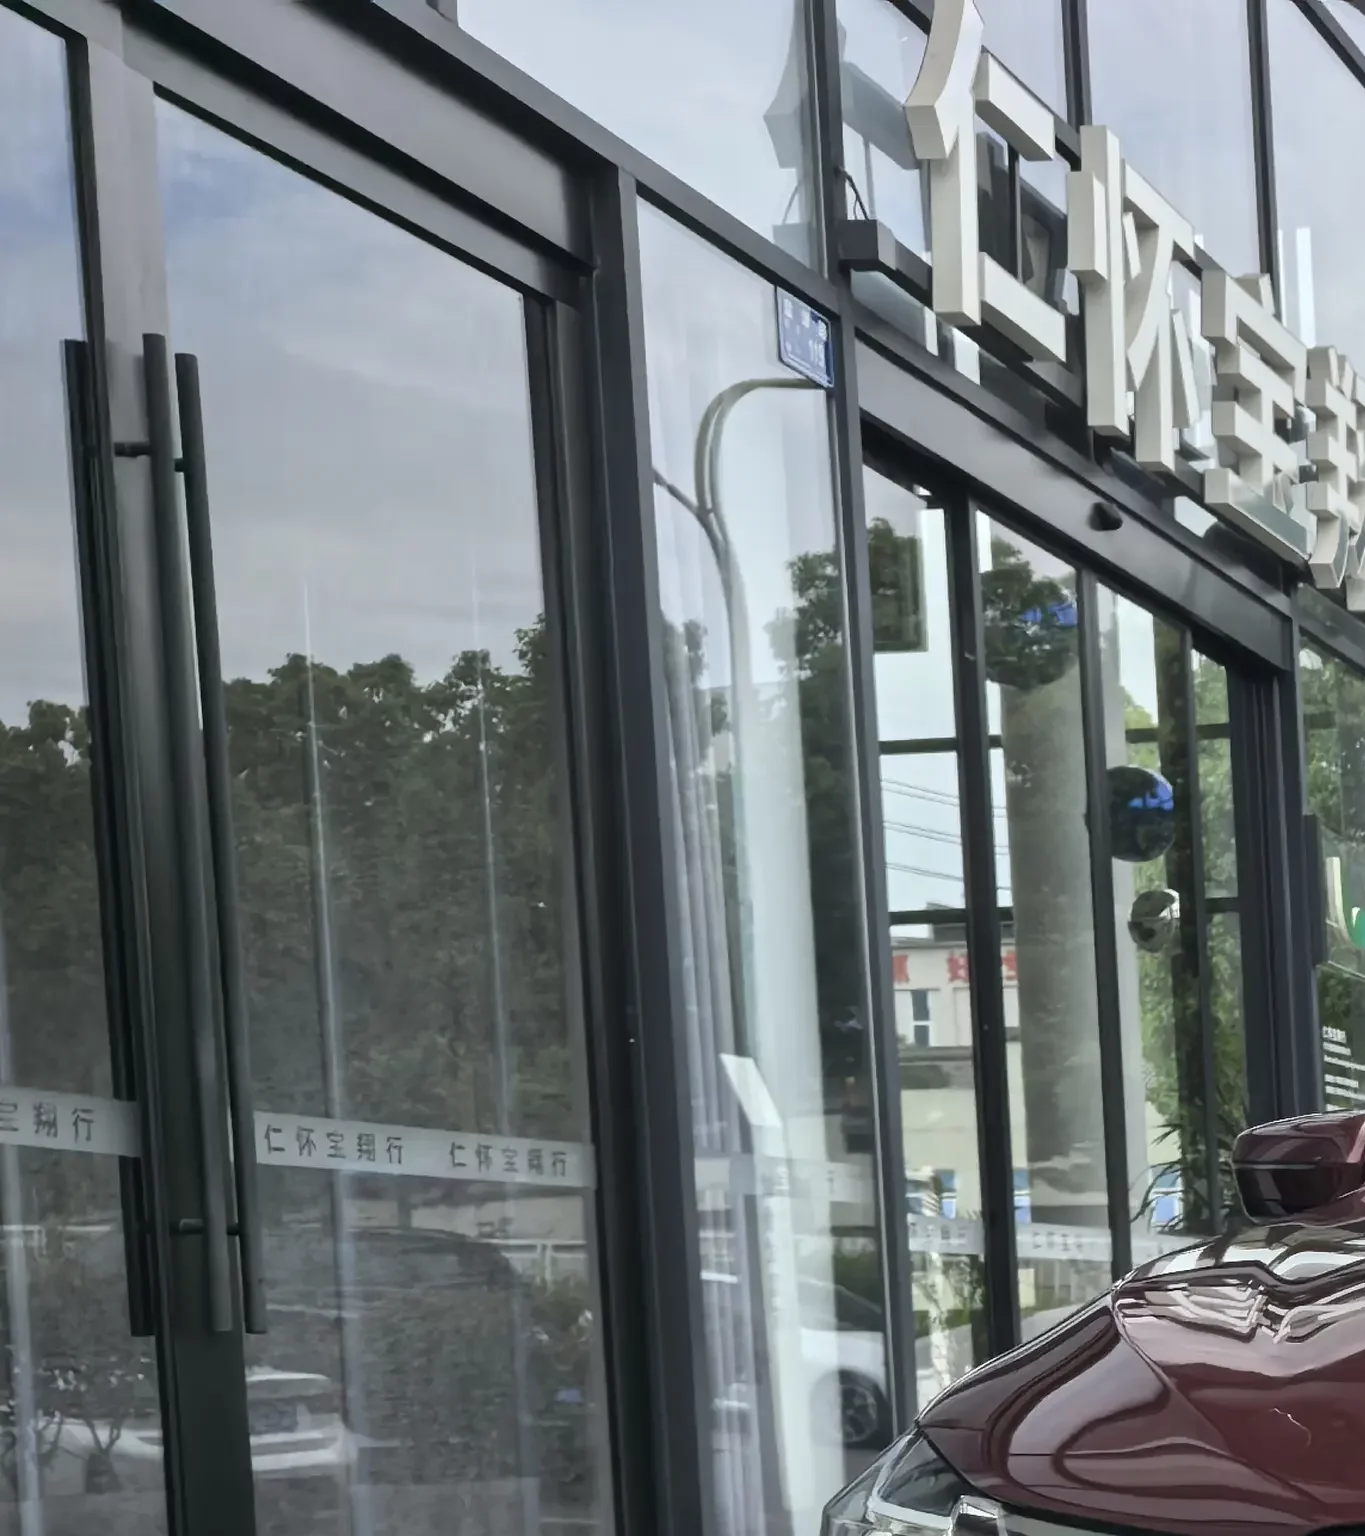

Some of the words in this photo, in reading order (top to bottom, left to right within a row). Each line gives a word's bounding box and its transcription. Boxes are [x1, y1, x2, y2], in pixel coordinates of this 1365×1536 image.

[264, 1124, 404, 1165] 仁怀宝翔行
